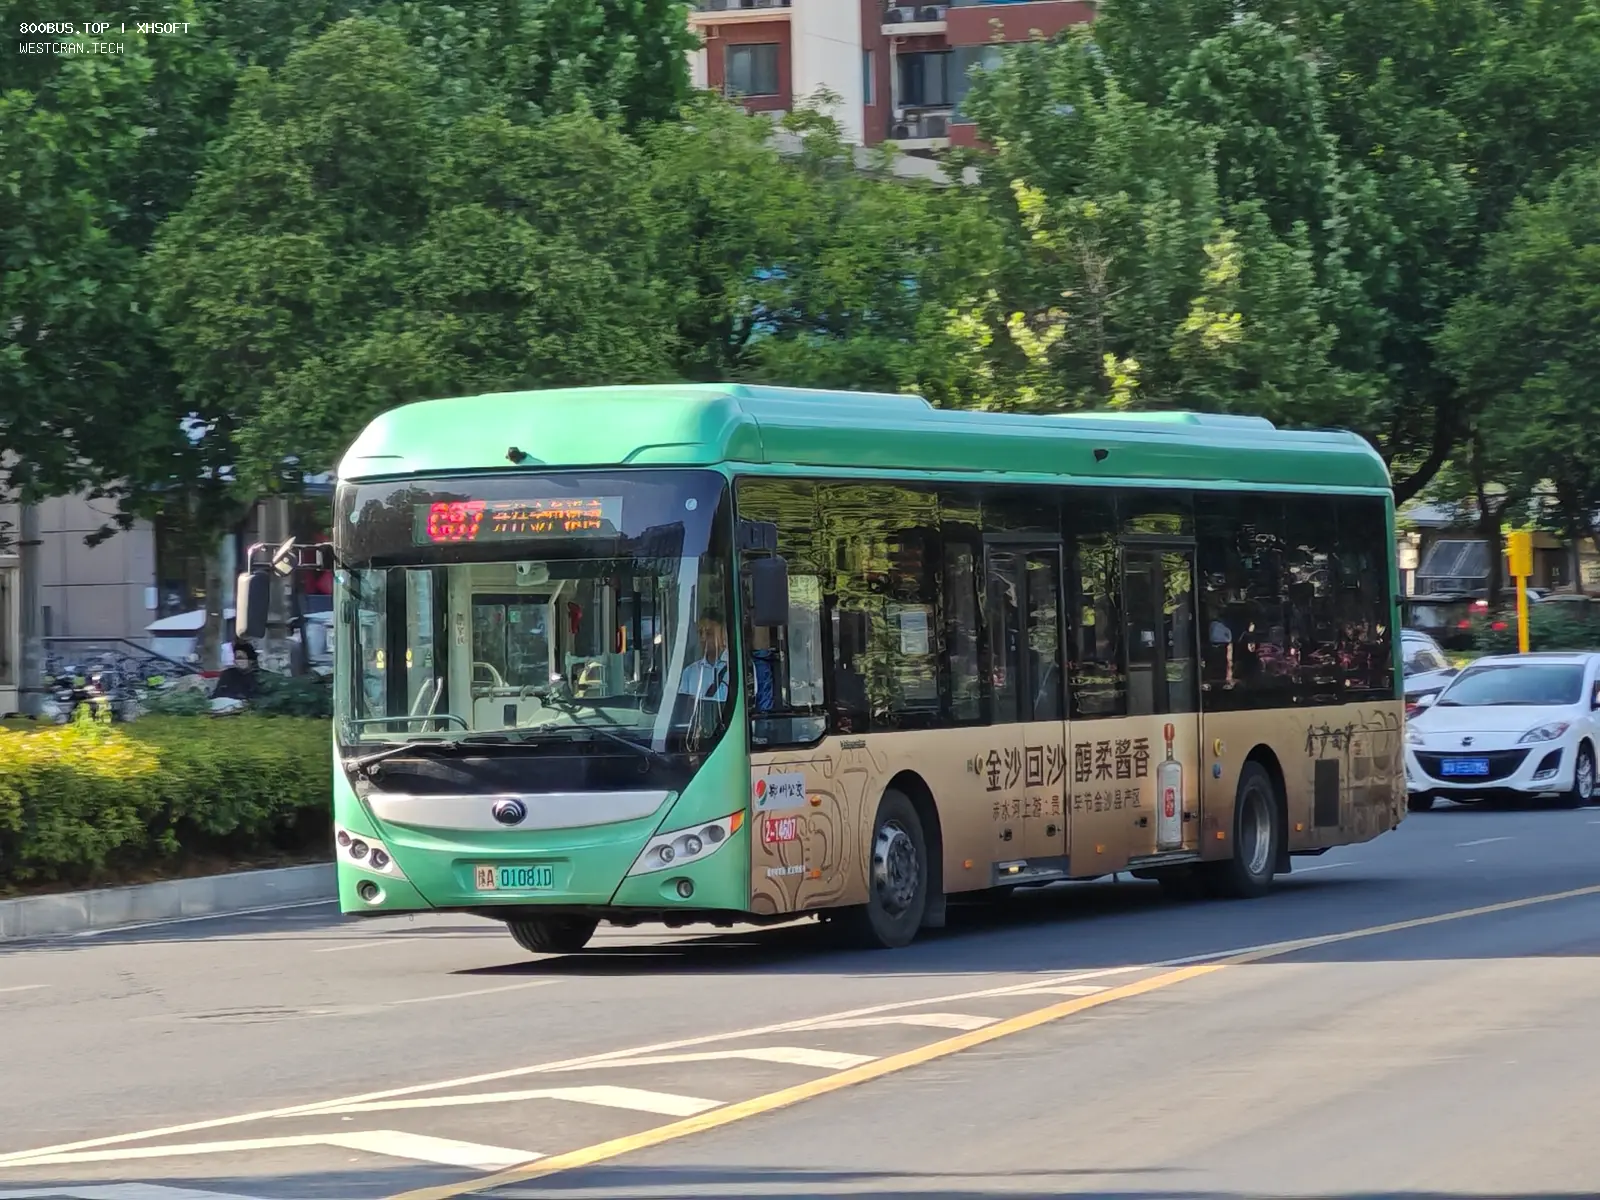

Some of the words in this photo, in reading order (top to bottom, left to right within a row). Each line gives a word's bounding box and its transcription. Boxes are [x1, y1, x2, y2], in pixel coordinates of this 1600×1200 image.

[986, 745, 1066, 791] 金沙回沙
[501, 868, 551, 886] 01081D
